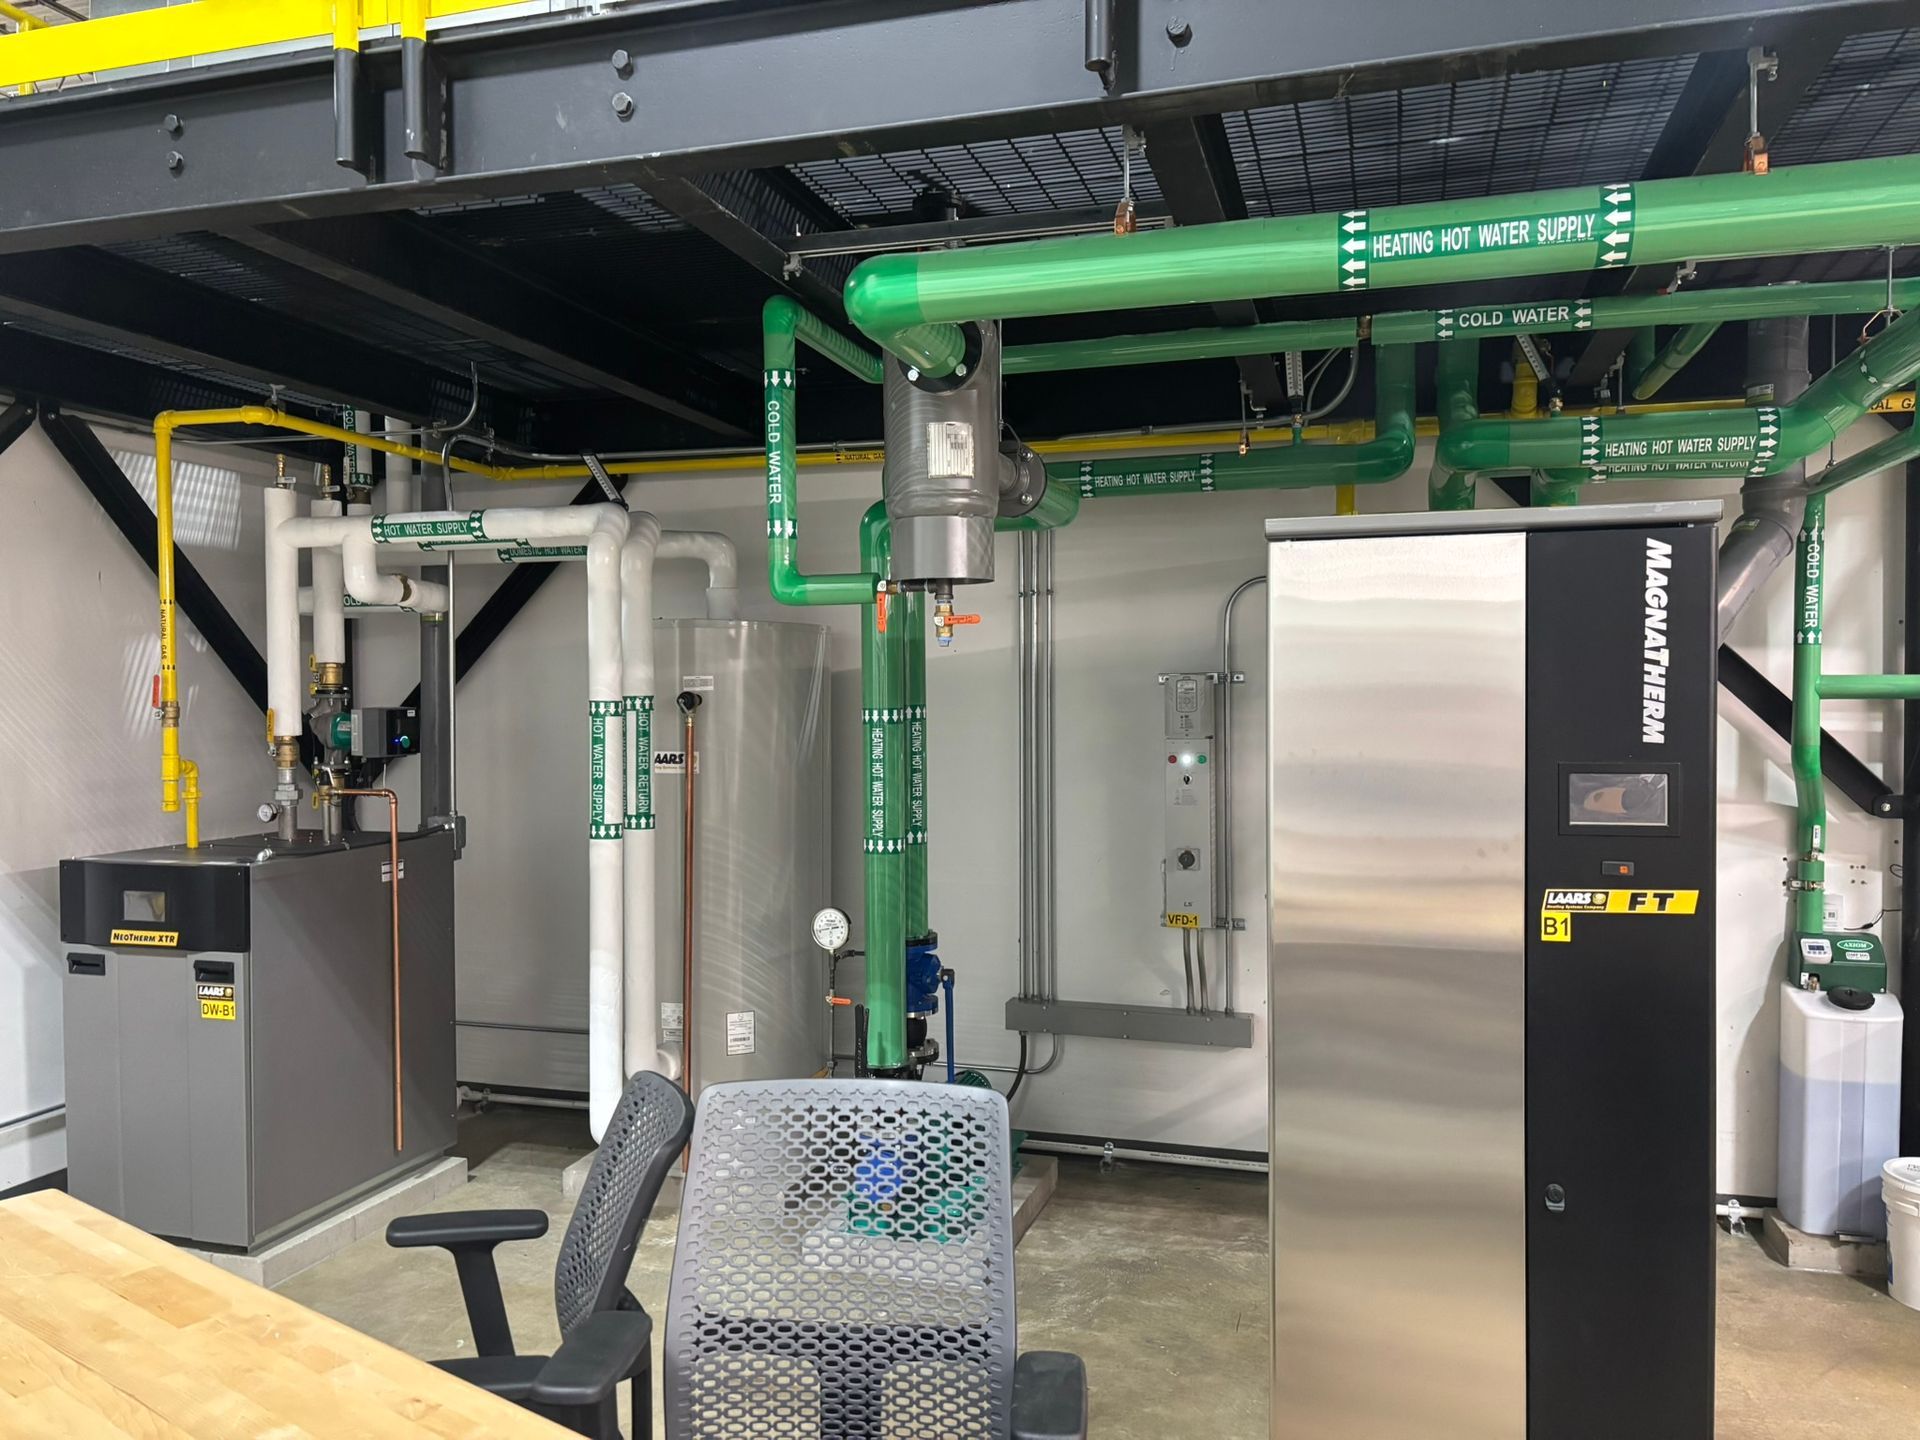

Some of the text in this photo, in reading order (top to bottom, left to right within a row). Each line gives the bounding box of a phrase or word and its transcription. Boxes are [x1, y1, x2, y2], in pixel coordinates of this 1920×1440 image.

[1373, 213, 1595, 258] HEATING HOT WATER SUPPLY
[1459, 306, 1569, 328] COLD WATER
[345, 410, 354, 432] COL
[767, 400, 782, 504] COLD WATER
[1605, 435, 1757, 457] HEATING HOT WATER SUPPLY
[1094, 470, 1196, 488] HEATING HOT WATER SUPPLY
[384, 522, 468, 536] HOT WATER SUPPLY
[1804, 543, 1820, 628] COLD WATER
[1642, 537, 1672, 744] MAGNATHERM
[638, 712, 649, 813] HOT WATER RETURN
[654, 753, 685, 764] AARS
[592, 718, 604, 823] HOT WATER SUPPLY
[911, 722, 923, 826] HEATING HOT WATER SUPPLY
[872, 728, 884, 838] HEATING HOT WATER SUPPLY
[1547, 892, 1592, 904] LAARS
[1168, 914, 1198, 925] VFD-1
[1543, 917, 1569, 936] B1
[158, 935, 175, 943] XTR
[199, 986, 225, 996] LAARS
[202, 1003, 235, 1017] DW-B1
